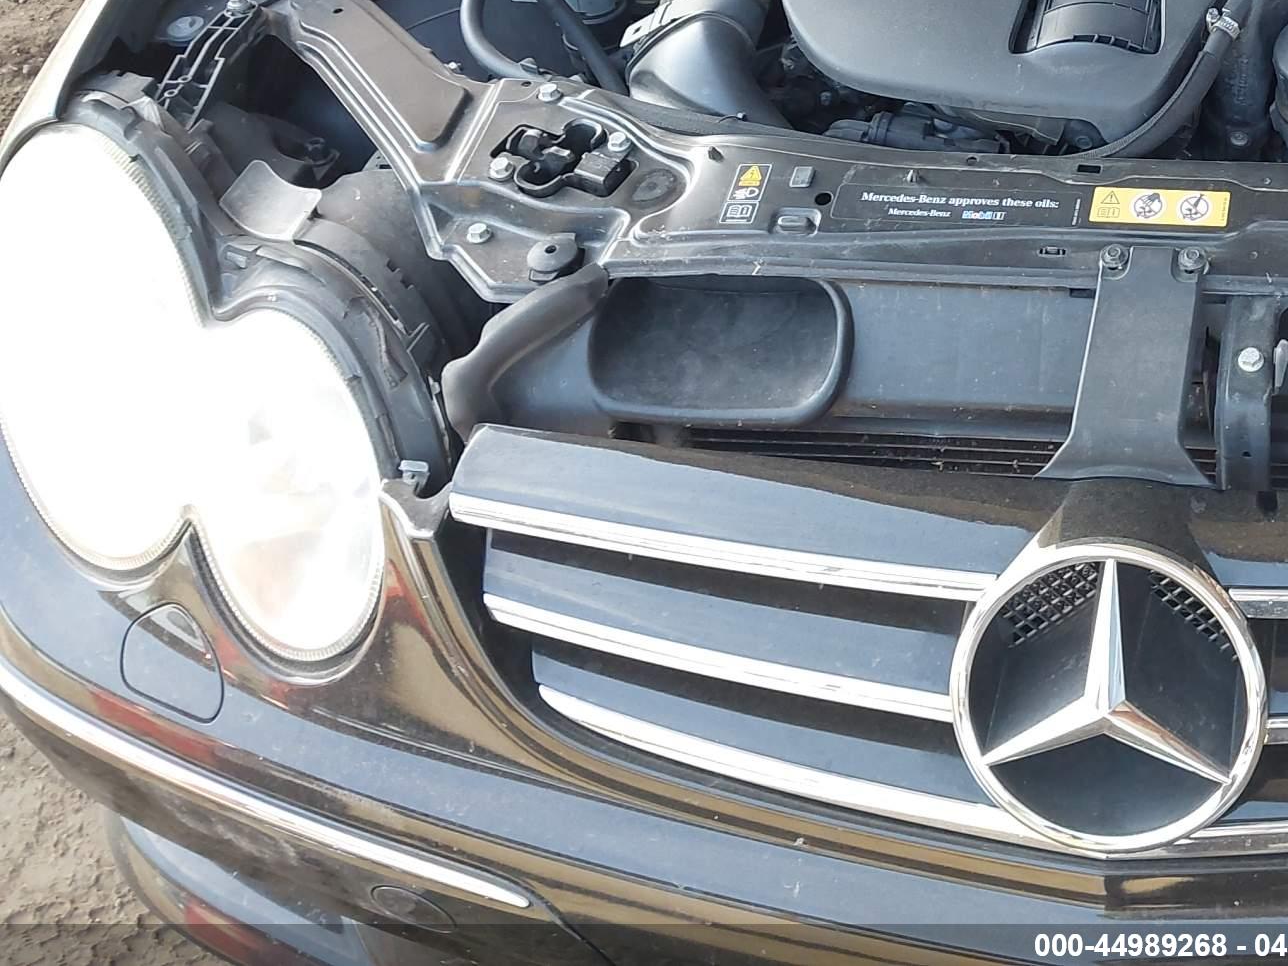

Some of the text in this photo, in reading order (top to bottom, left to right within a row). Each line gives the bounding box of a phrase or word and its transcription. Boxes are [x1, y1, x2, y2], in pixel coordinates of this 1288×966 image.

[861, 191, 1060, 209] Mercedes-Benz approves these oils:
[887, 207, 952, 218] Mercedes-Benz
